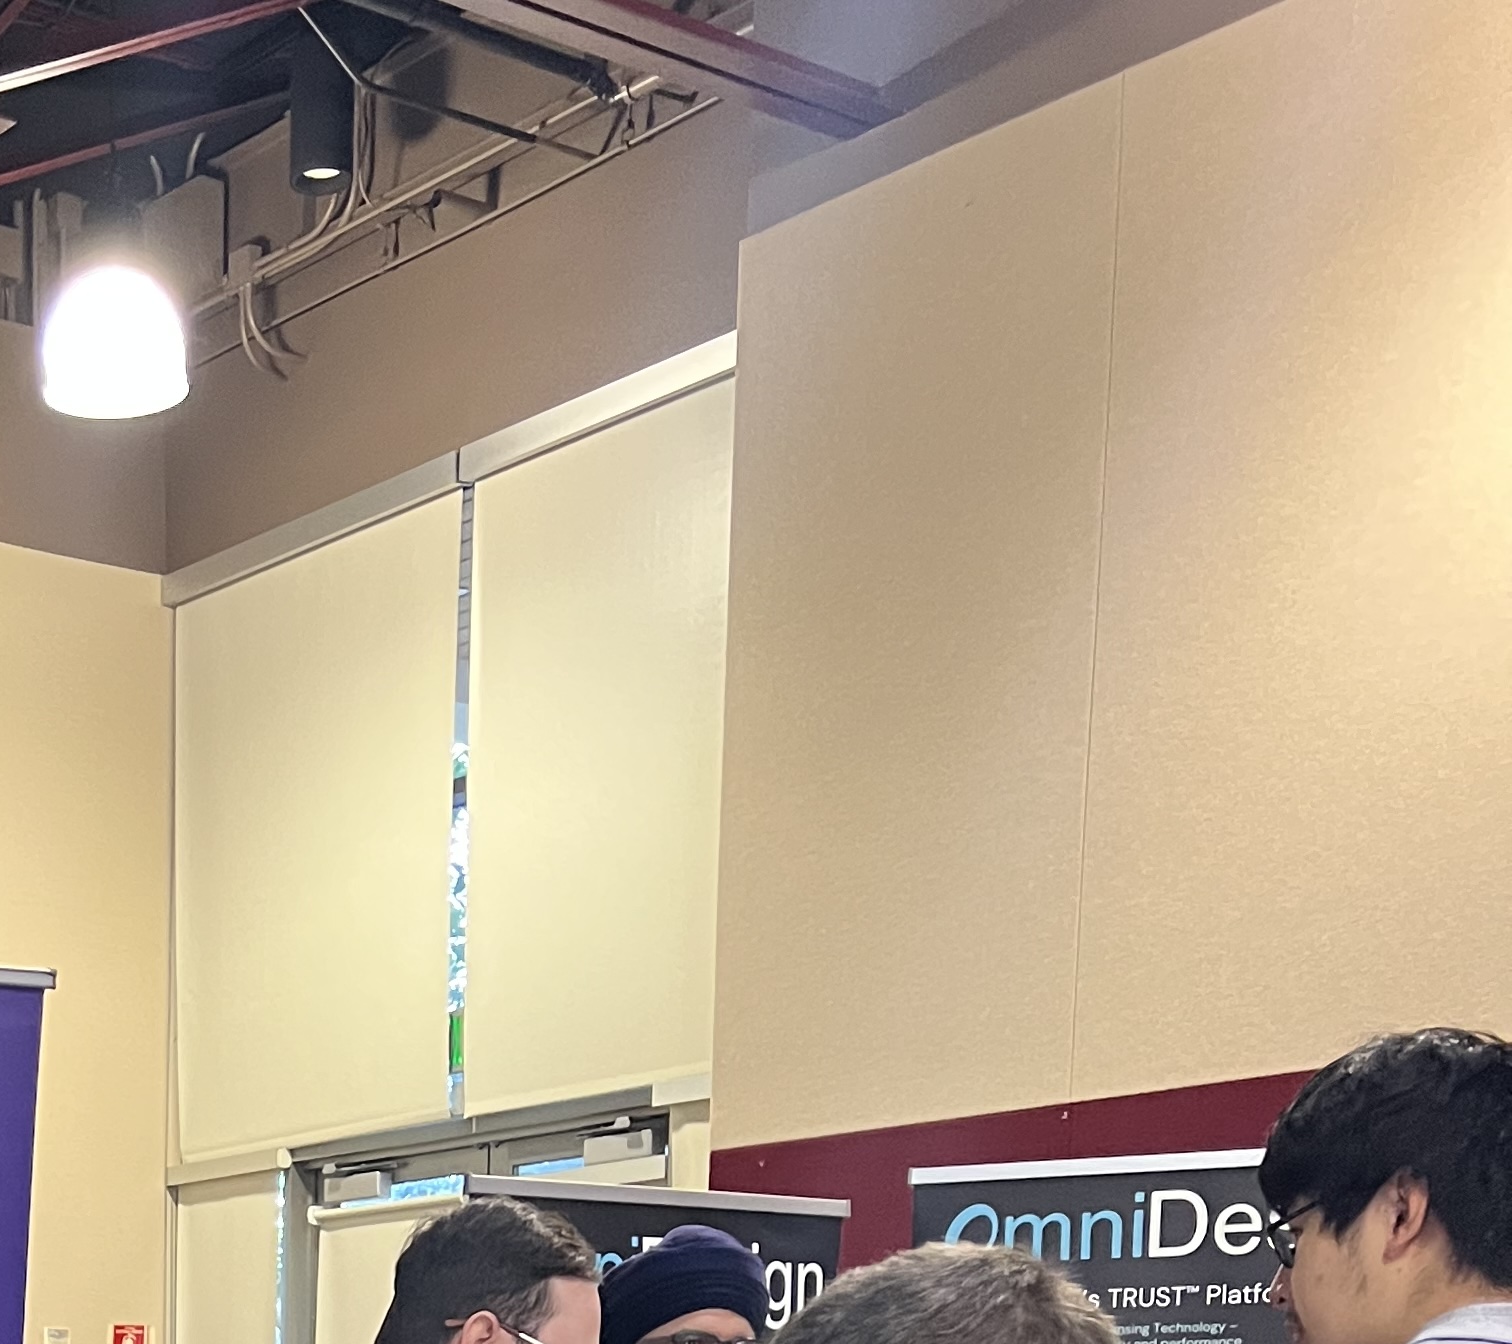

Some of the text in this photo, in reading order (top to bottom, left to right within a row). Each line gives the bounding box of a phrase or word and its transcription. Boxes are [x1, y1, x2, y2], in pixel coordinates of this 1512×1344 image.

[944, 1189, 1294, 1261] OmniDe
[1205, 1282, 1271, 1305] Platfo
[1154, 1321, 1226, 1335] Technology
